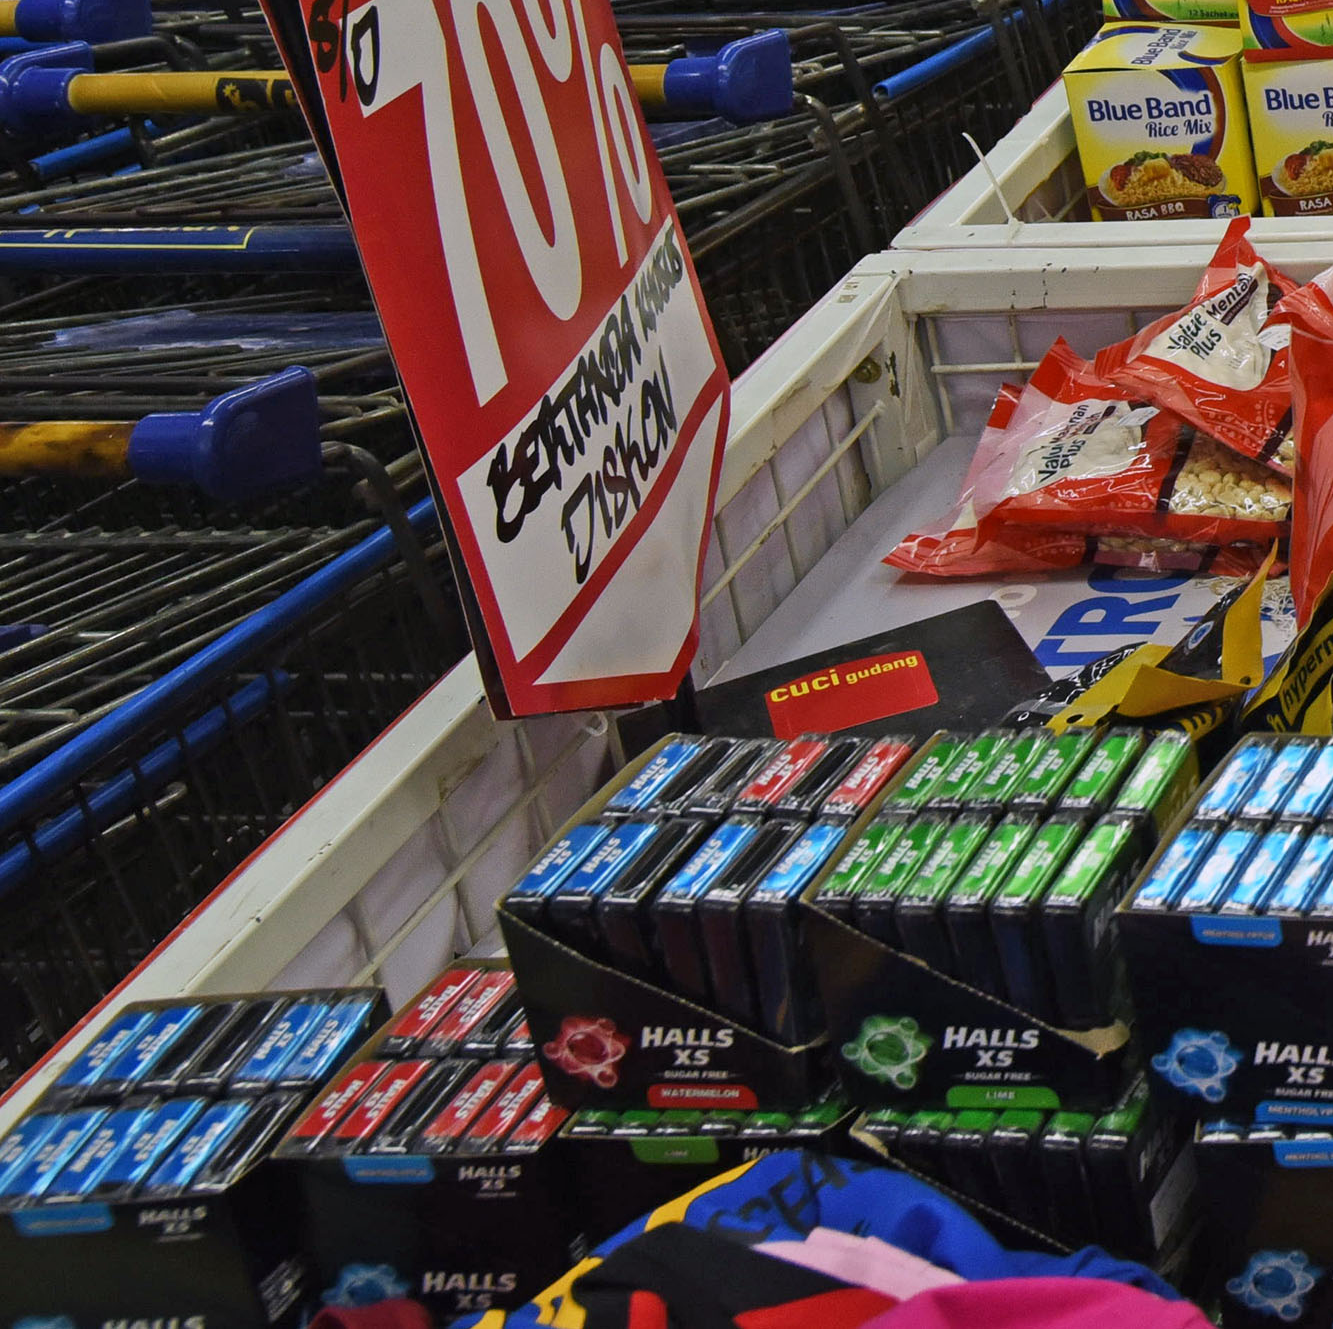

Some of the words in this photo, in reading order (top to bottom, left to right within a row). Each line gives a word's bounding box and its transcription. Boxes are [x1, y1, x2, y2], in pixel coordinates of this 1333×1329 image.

[1087, 98, 1143, 123] Blue
[1145, 92, 1213, 119] Band
[1264, 87, 1321, 112] Blue
[1166, 310, 1208, 352] Value
[1190, 325, 1222, 361] Plus
[486, 292, 643, 544] BERTANDA
[561, 346, 678, 586] DISKON
[768, 670, 842, 706] cuci
[845, 652, 919, 686] gudang
[640, 1025, 734, 1049] HALLS
[944, 1026, 1040, 1050] HALLS
[673, 1047, 711, 1067] XS
[976, 1048, 1013, 1068] XS
[964, 1071, 1000, 1081] SUGAR
[1003, 1071, 1033, 1082] FREE
[1285, 1066, 1325, 1085] XS
[661, 1088, 740, 1099] WATERMELON
[984, 1090, 1017, 1101] LIME
[1274, 1087, 1312, 1099] SUGAR
[458, 1164, 522, 1182] HALLS
[422, 1271, 517, 1294] HALLS
